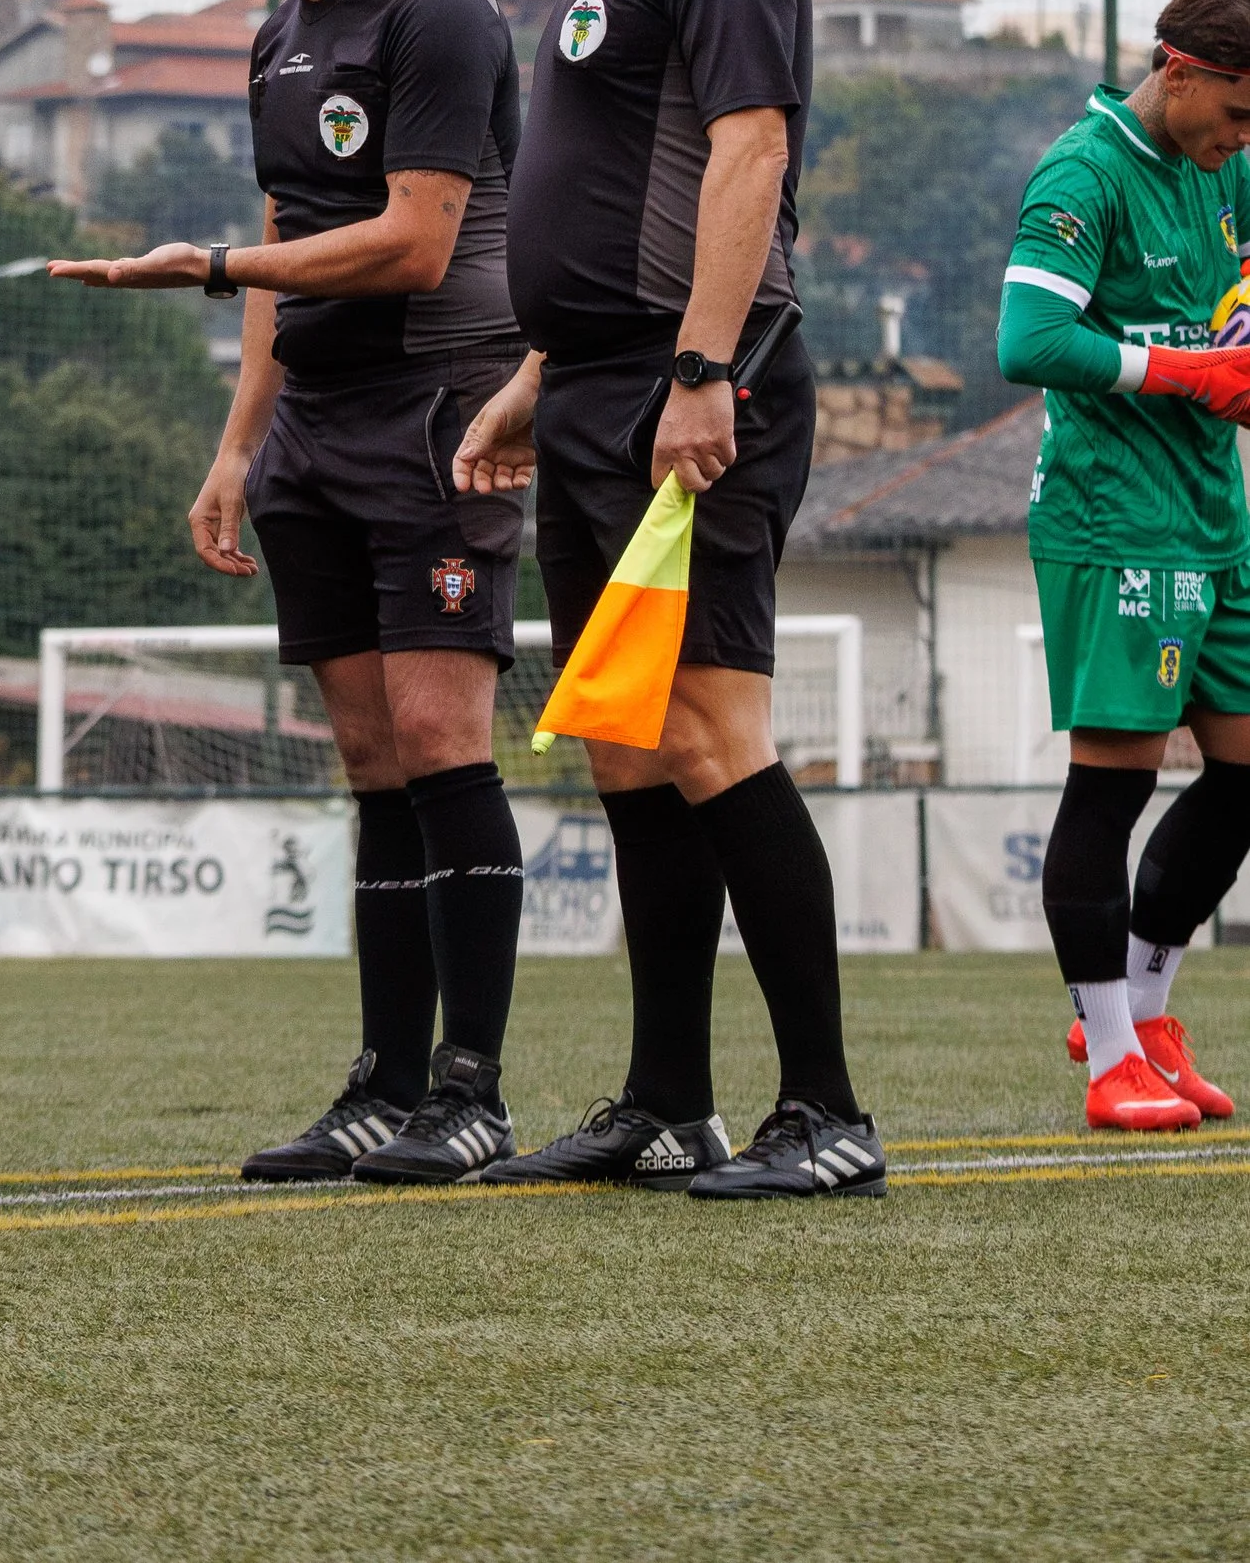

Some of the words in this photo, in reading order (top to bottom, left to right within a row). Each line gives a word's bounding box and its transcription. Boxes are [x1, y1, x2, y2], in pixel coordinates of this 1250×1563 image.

[1118, 599, 1150, 617] MC
[102, 855, 226, 894] TIRSO
[635, 1154, 695, 1170] adidas
